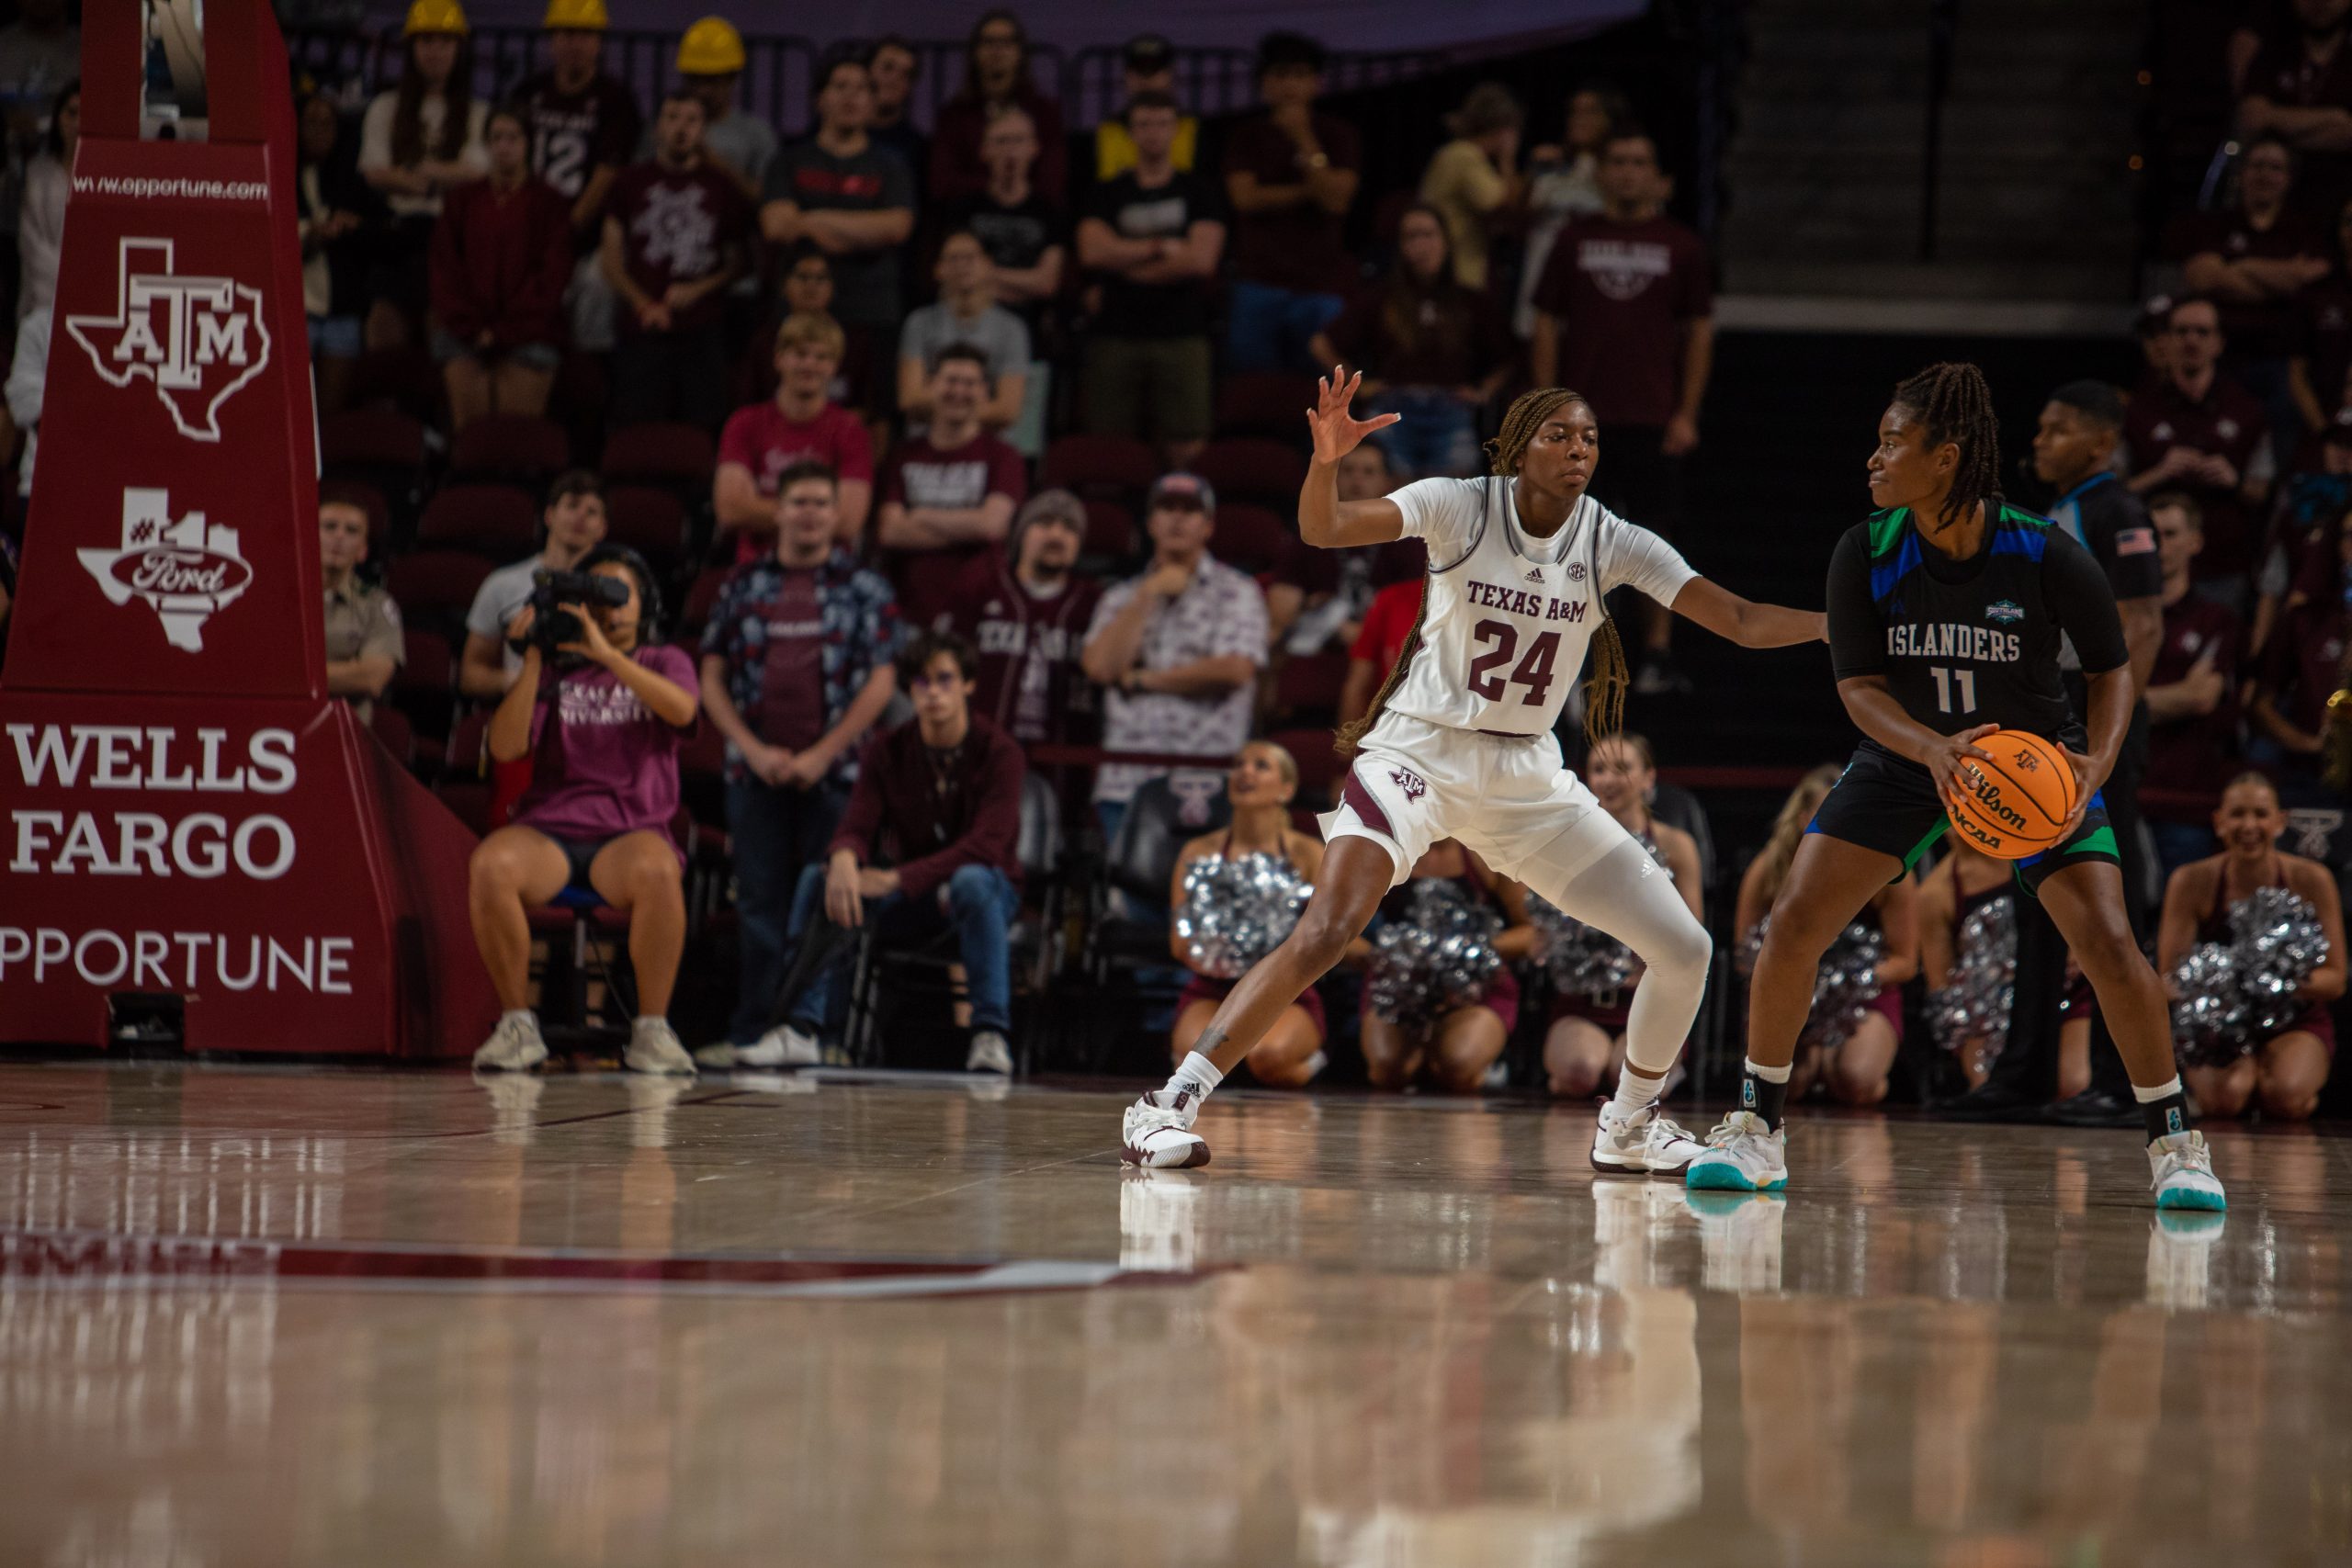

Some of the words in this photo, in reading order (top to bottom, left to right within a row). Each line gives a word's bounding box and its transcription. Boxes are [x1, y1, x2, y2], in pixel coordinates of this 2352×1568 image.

[131, 552, 228, 593] Ford
[1523, 574, 1545, 584] adidas
[1570, 564, 1586, 580] SEC
[1468, 580, 1542, 617] TEXAS
[1545, 597, 1588, 623] A&M
[1468, 618, 1562, 706] 24
[1887, 623, 2020, 662] ISLANDERS
[1930, 666, 1976, 714] 11
[6, 722, 298, 795] WELLS
[9, 809, 297, 880] FARGO
[1951, 803, 2002, 850] NCAA
[0, 926, 355, 994] PPORTUNE
